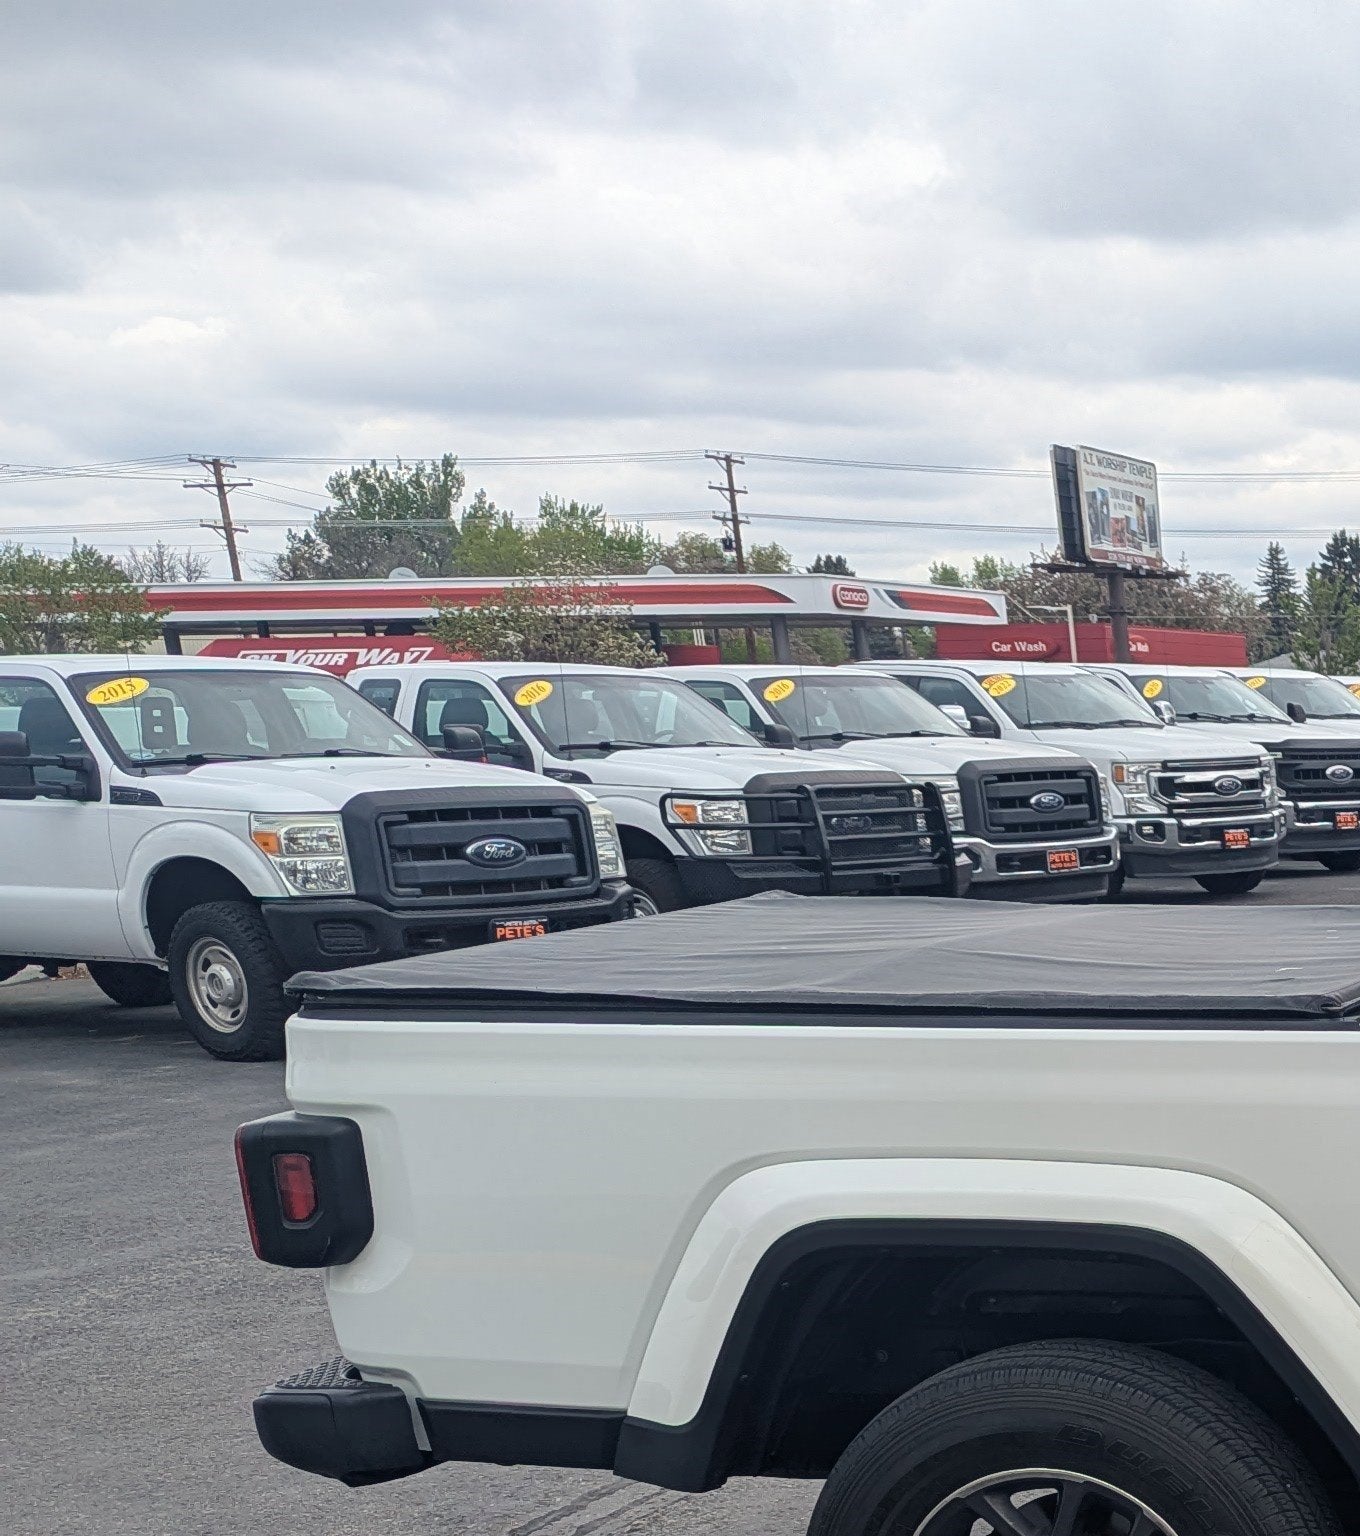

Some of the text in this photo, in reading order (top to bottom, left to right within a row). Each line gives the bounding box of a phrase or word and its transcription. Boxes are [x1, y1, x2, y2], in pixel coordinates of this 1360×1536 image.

[1096, 454, 1127, 473] WORSHIP
[1128, 462, 1153, 480] TEMPLE
[991, 641, 1047, 652] Car Wash
[284, 649, 345, 666] YOUR
[356, 648, 419, 665] WAY
[98, 679, 137, 703] 2015
[520, 682, 547, 704] 2016
[482, 843, 515, 859] Ford
[1049, 851, 1077, 863] PETE'S
[496, 924, 545, 940] PETE'S
